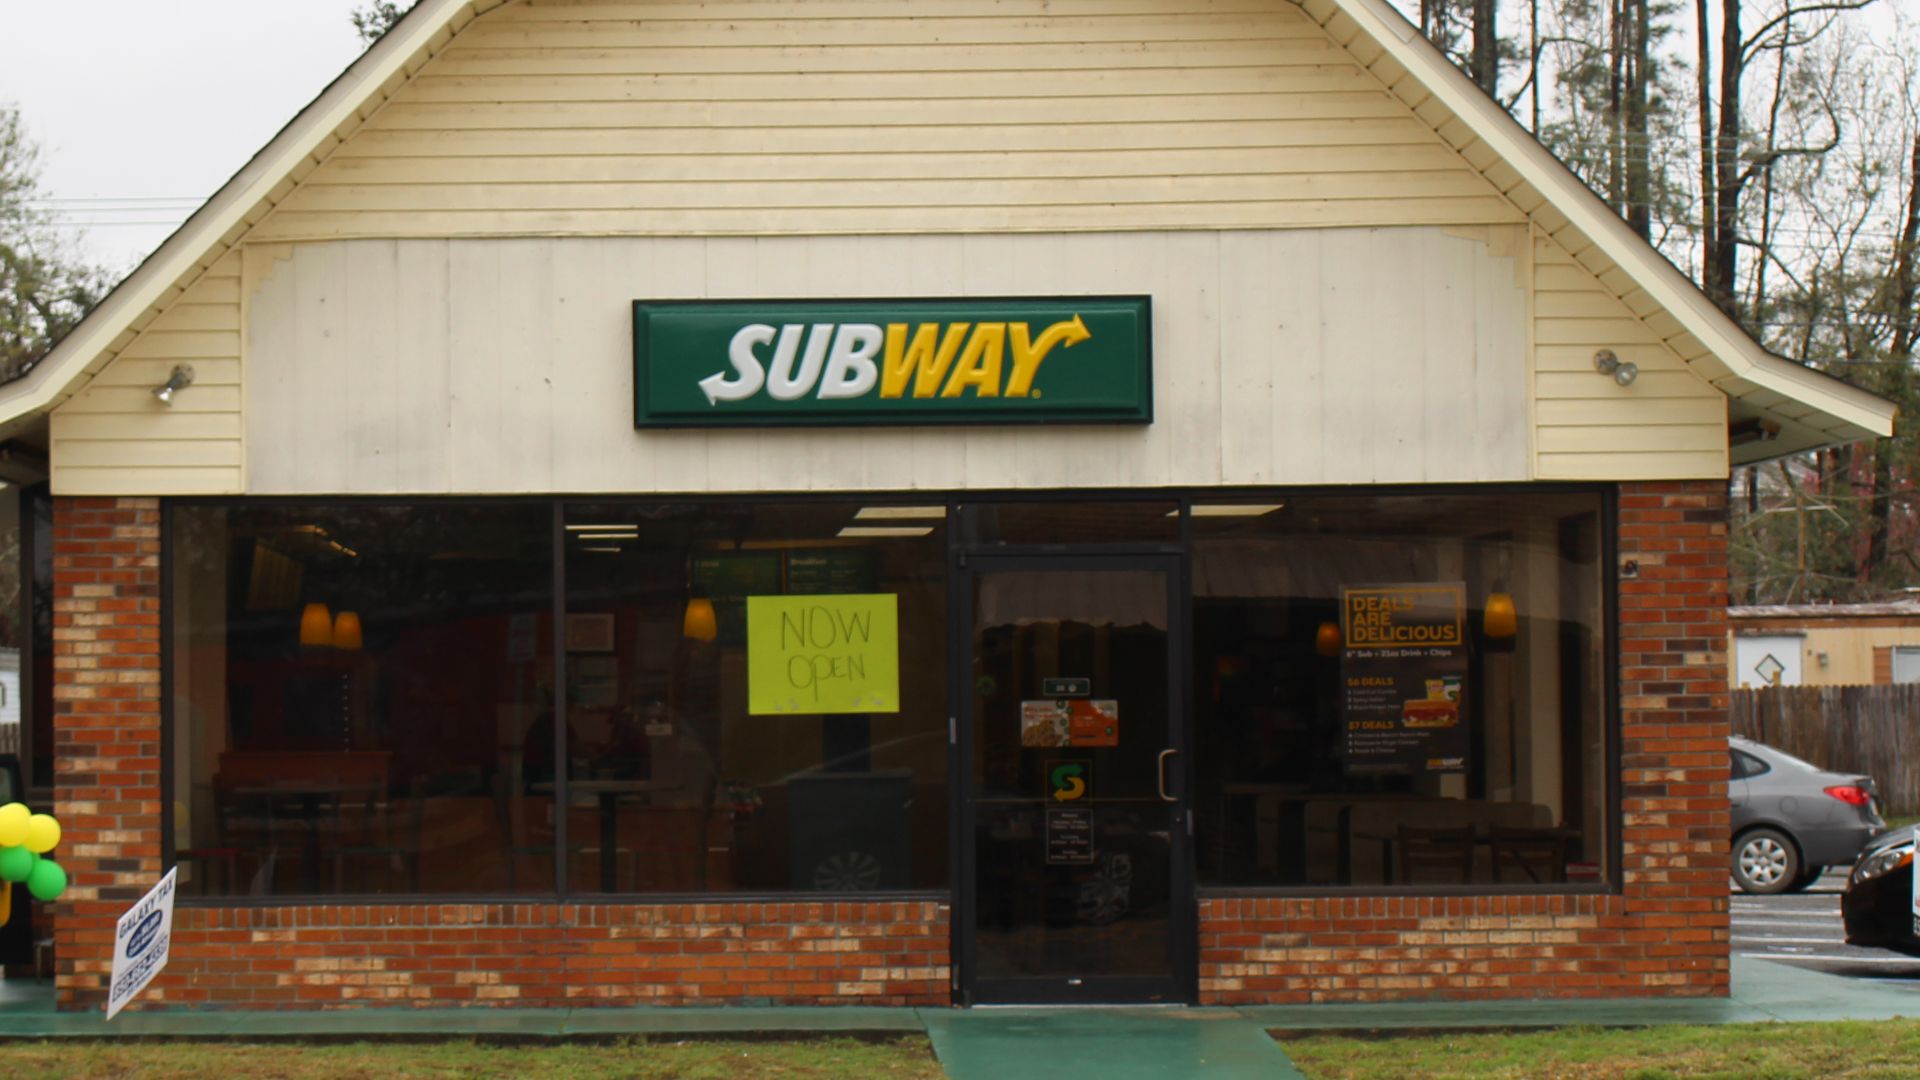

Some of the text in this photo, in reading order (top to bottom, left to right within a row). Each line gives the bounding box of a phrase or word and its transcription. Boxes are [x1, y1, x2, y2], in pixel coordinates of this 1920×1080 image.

[698, 313, 1092, 406] SUBWAY
[1354, 597, 1414, 611] DEALS
[1354, 612, 1392, 626] ARE
[781, 604, 872, 651] NOW
[1354, 624, 1455, 641] DELICIOUS
[1361, 676, 1394, 687] DEALS
[1362, 720, 1395, 730] DEALS
[119, 898, 156, 940] GALAXY
[158, 878, 174, 902] TAX
